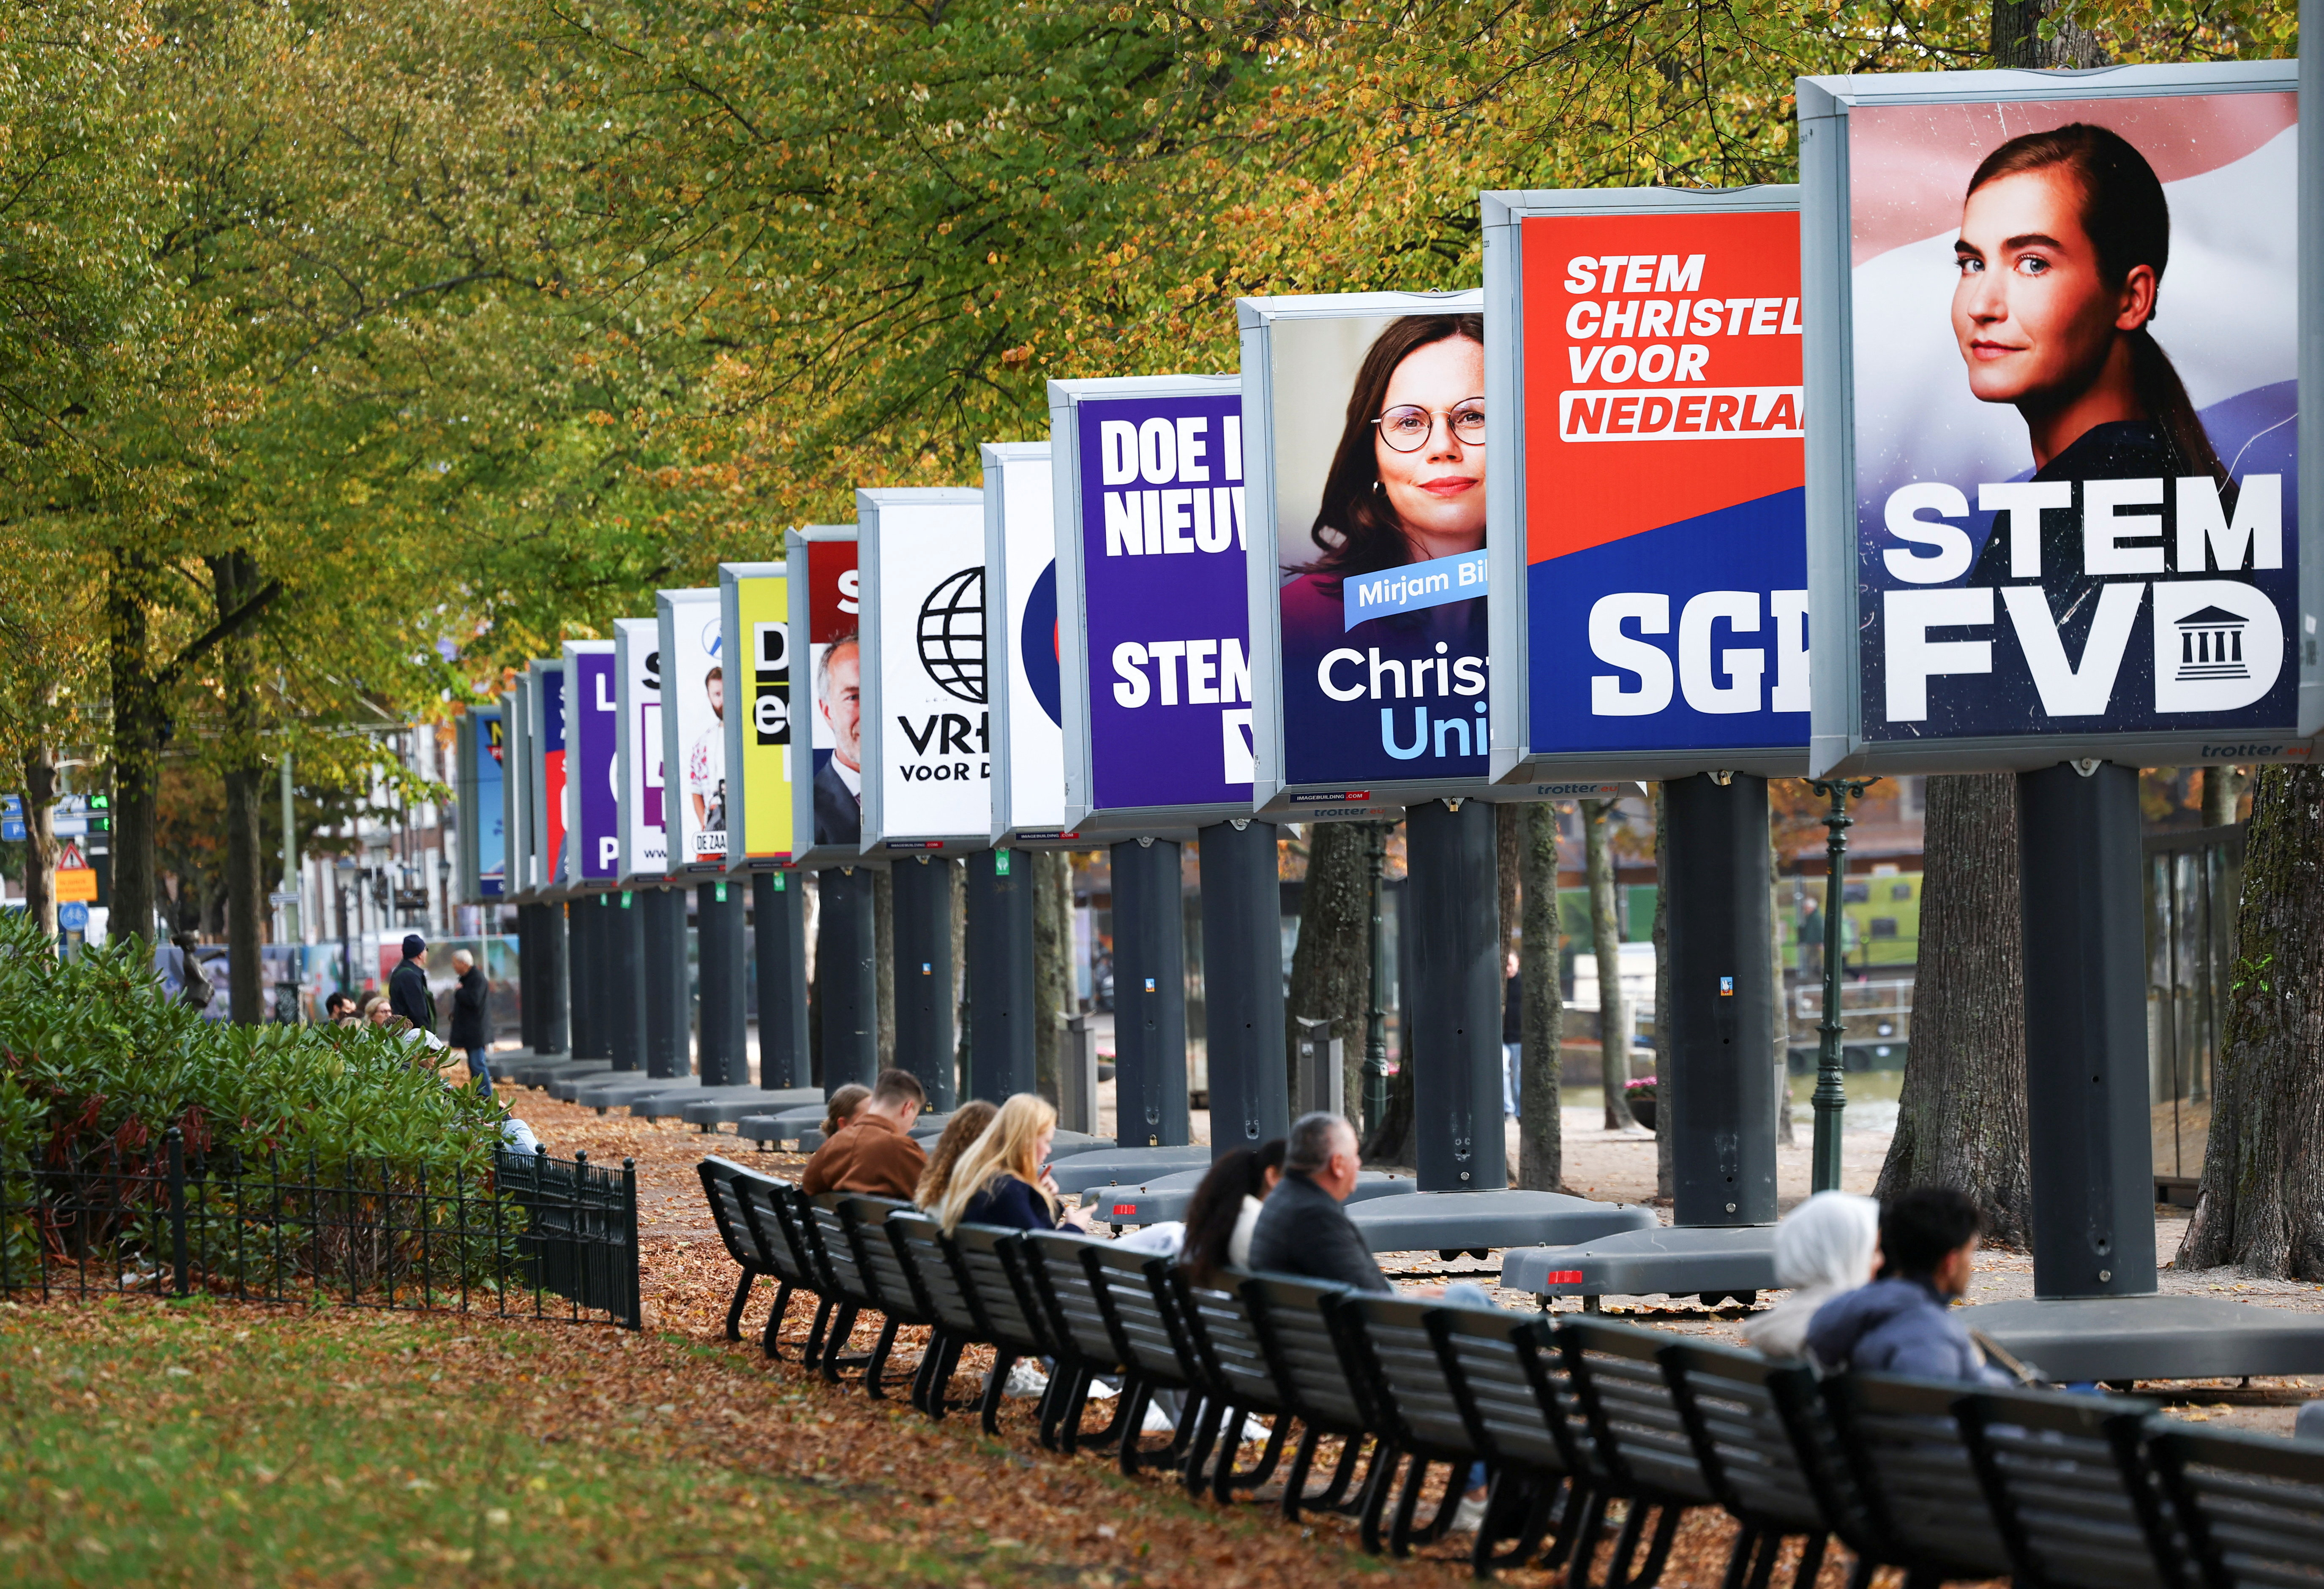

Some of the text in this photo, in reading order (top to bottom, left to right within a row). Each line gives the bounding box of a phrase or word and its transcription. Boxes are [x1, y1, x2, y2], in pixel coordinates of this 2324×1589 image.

[1564, 254, 1706, 294] STEM
[1566, 297, 1802, 339] CHRISTEL
[1568, 344, 1709, 383] VOOR
[1566, 394, 1804, 434] NEDERLA
[1101, 417, 1210, 485] DOE
[1883, 474, 2282, 583] STEM
[1359, 573, 1448, 607] Mirjam
[1883, 580, 2283, 722] FVD
[1317, 642, 1489, 701] Chris
[899, 763, 970, 782] VOOR
[697, 835, 707, 850] DE
